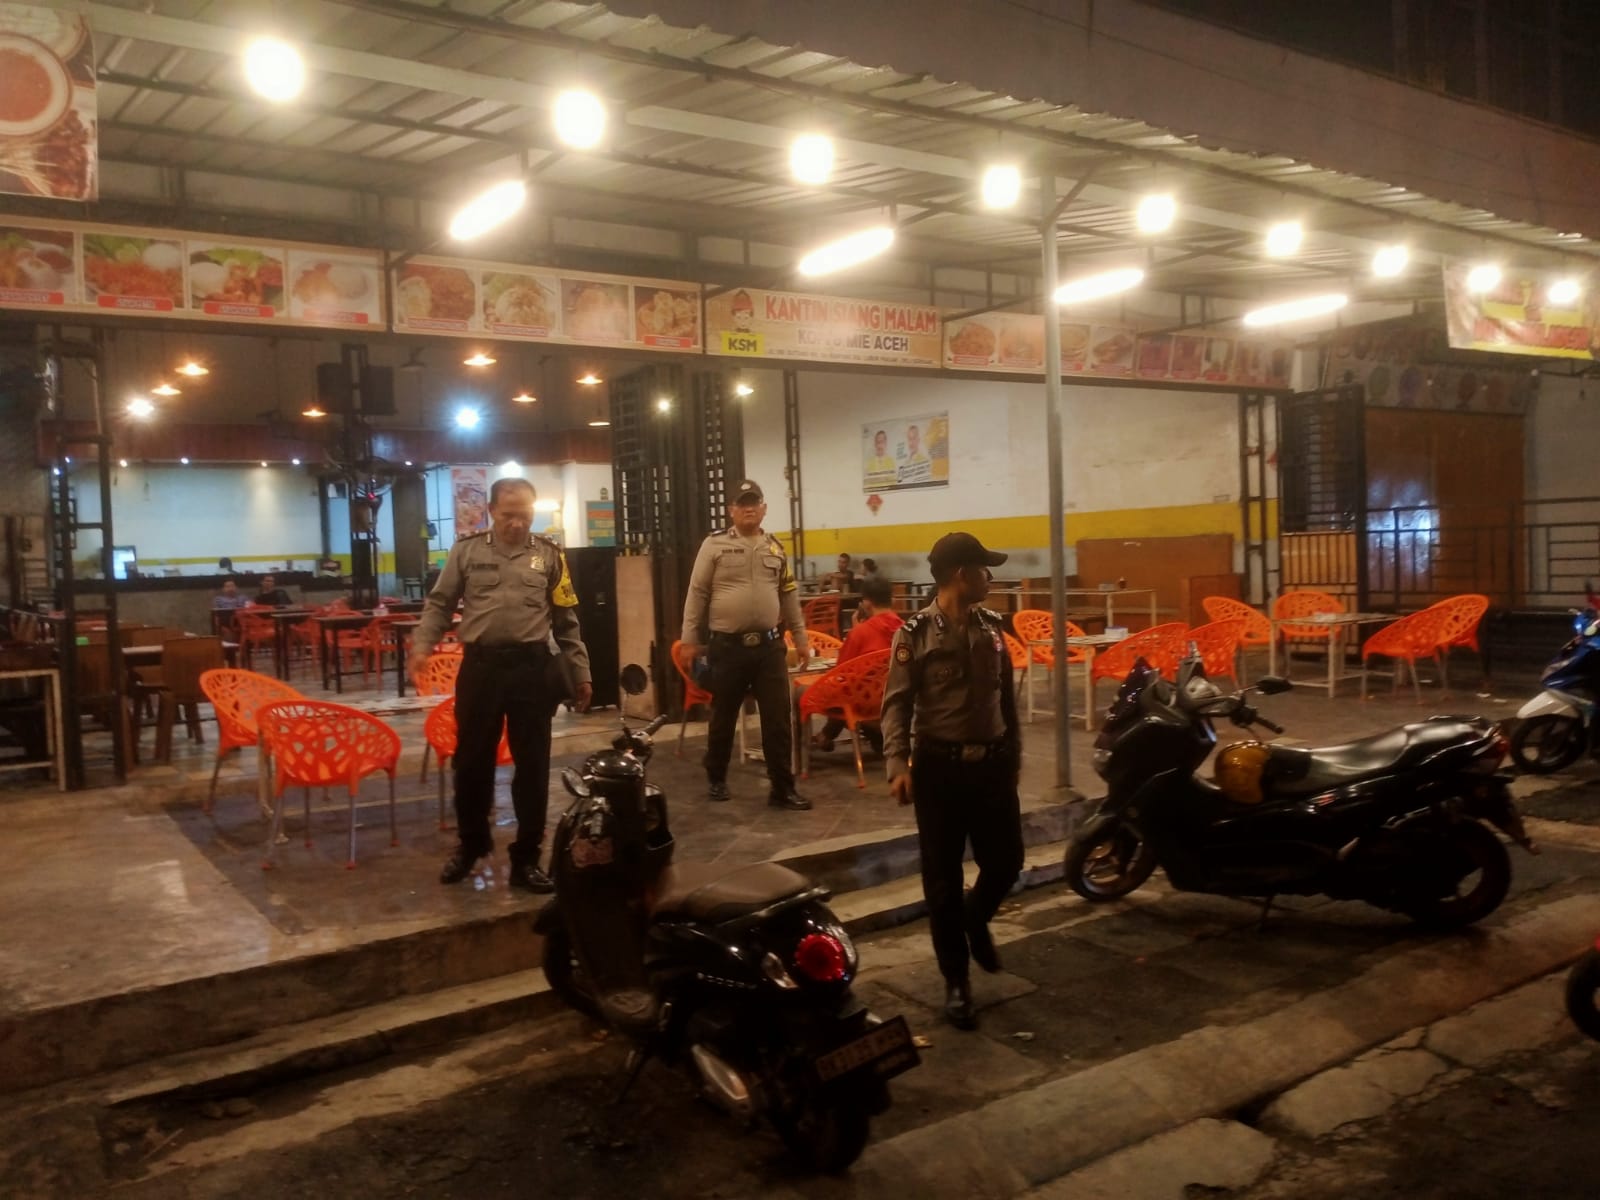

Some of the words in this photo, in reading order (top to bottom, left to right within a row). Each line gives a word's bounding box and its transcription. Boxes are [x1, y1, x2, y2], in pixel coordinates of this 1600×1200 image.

[766, 295, 827, 321] KANTIN
[885, 306, 937, 334] MALAM
[728, 337, 757, 352] KSM
[874, 336, 909, 351] ACEH
